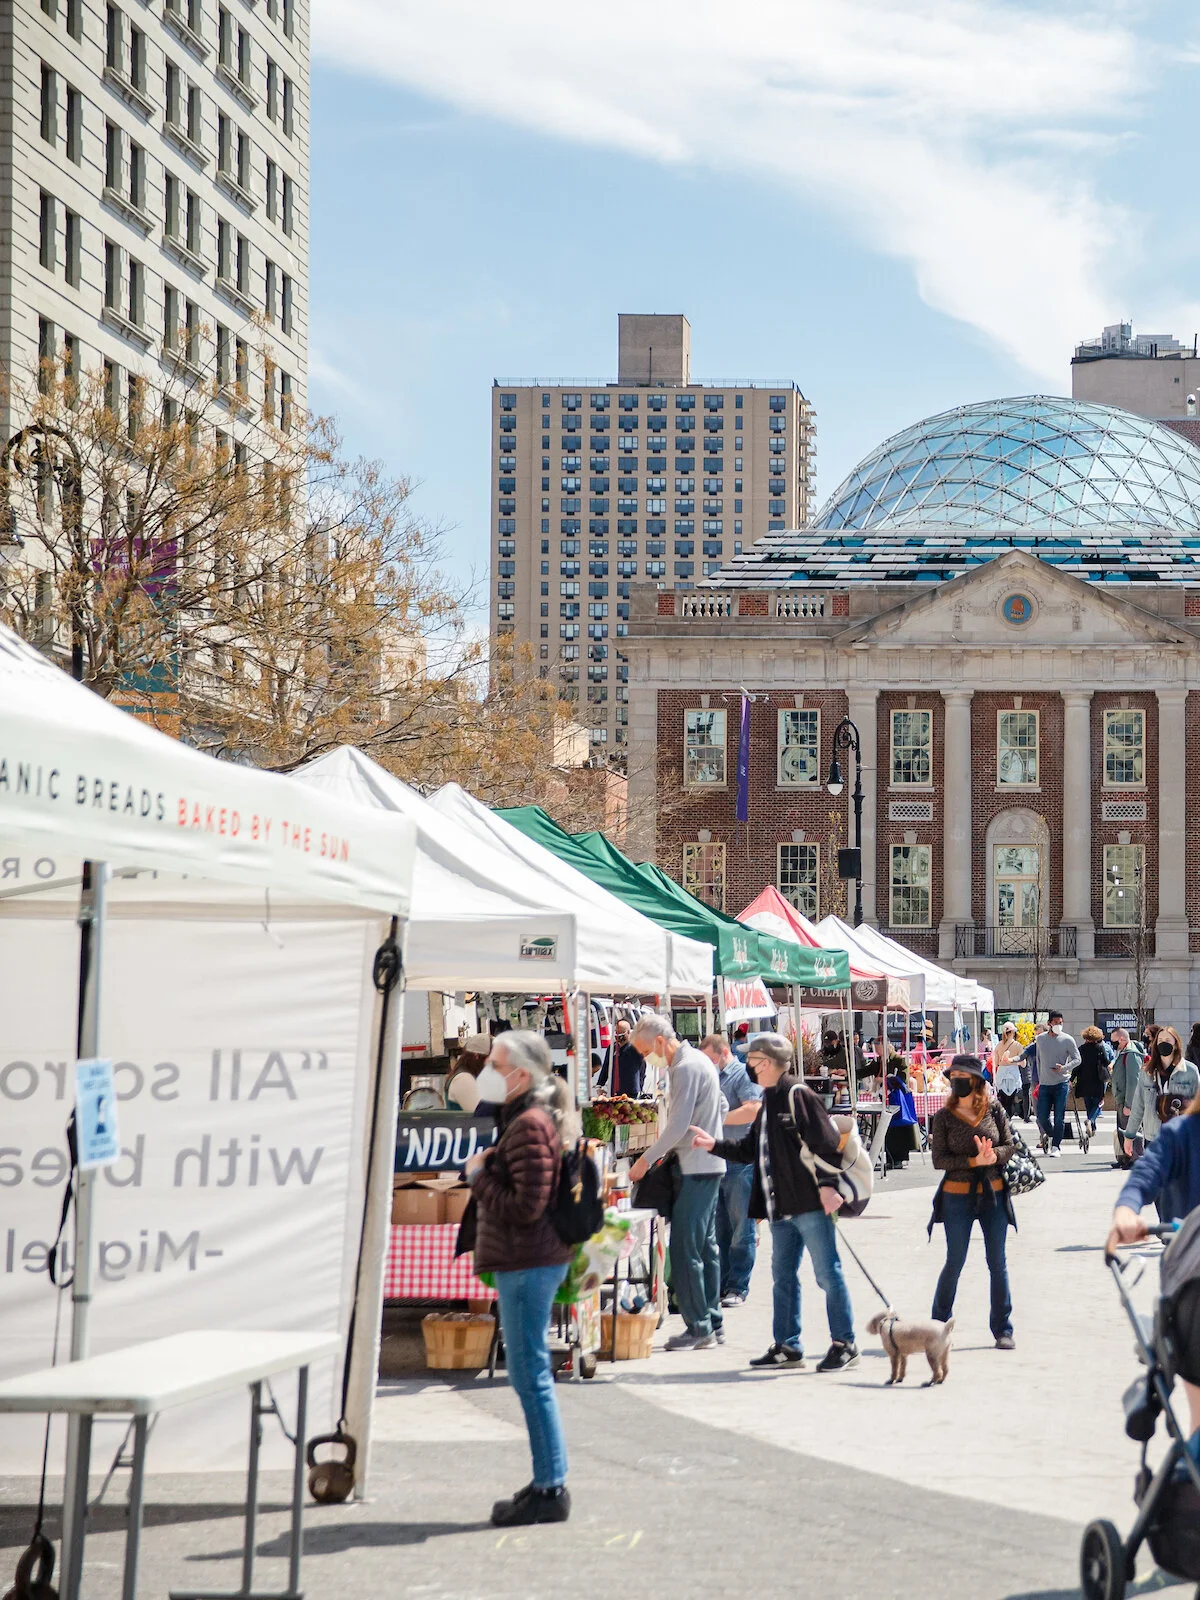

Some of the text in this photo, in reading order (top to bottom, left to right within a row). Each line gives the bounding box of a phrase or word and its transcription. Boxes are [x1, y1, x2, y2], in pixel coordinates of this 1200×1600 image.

[0, 758, 350, 863] ANIC BREADS BAKED BY THE SUN
